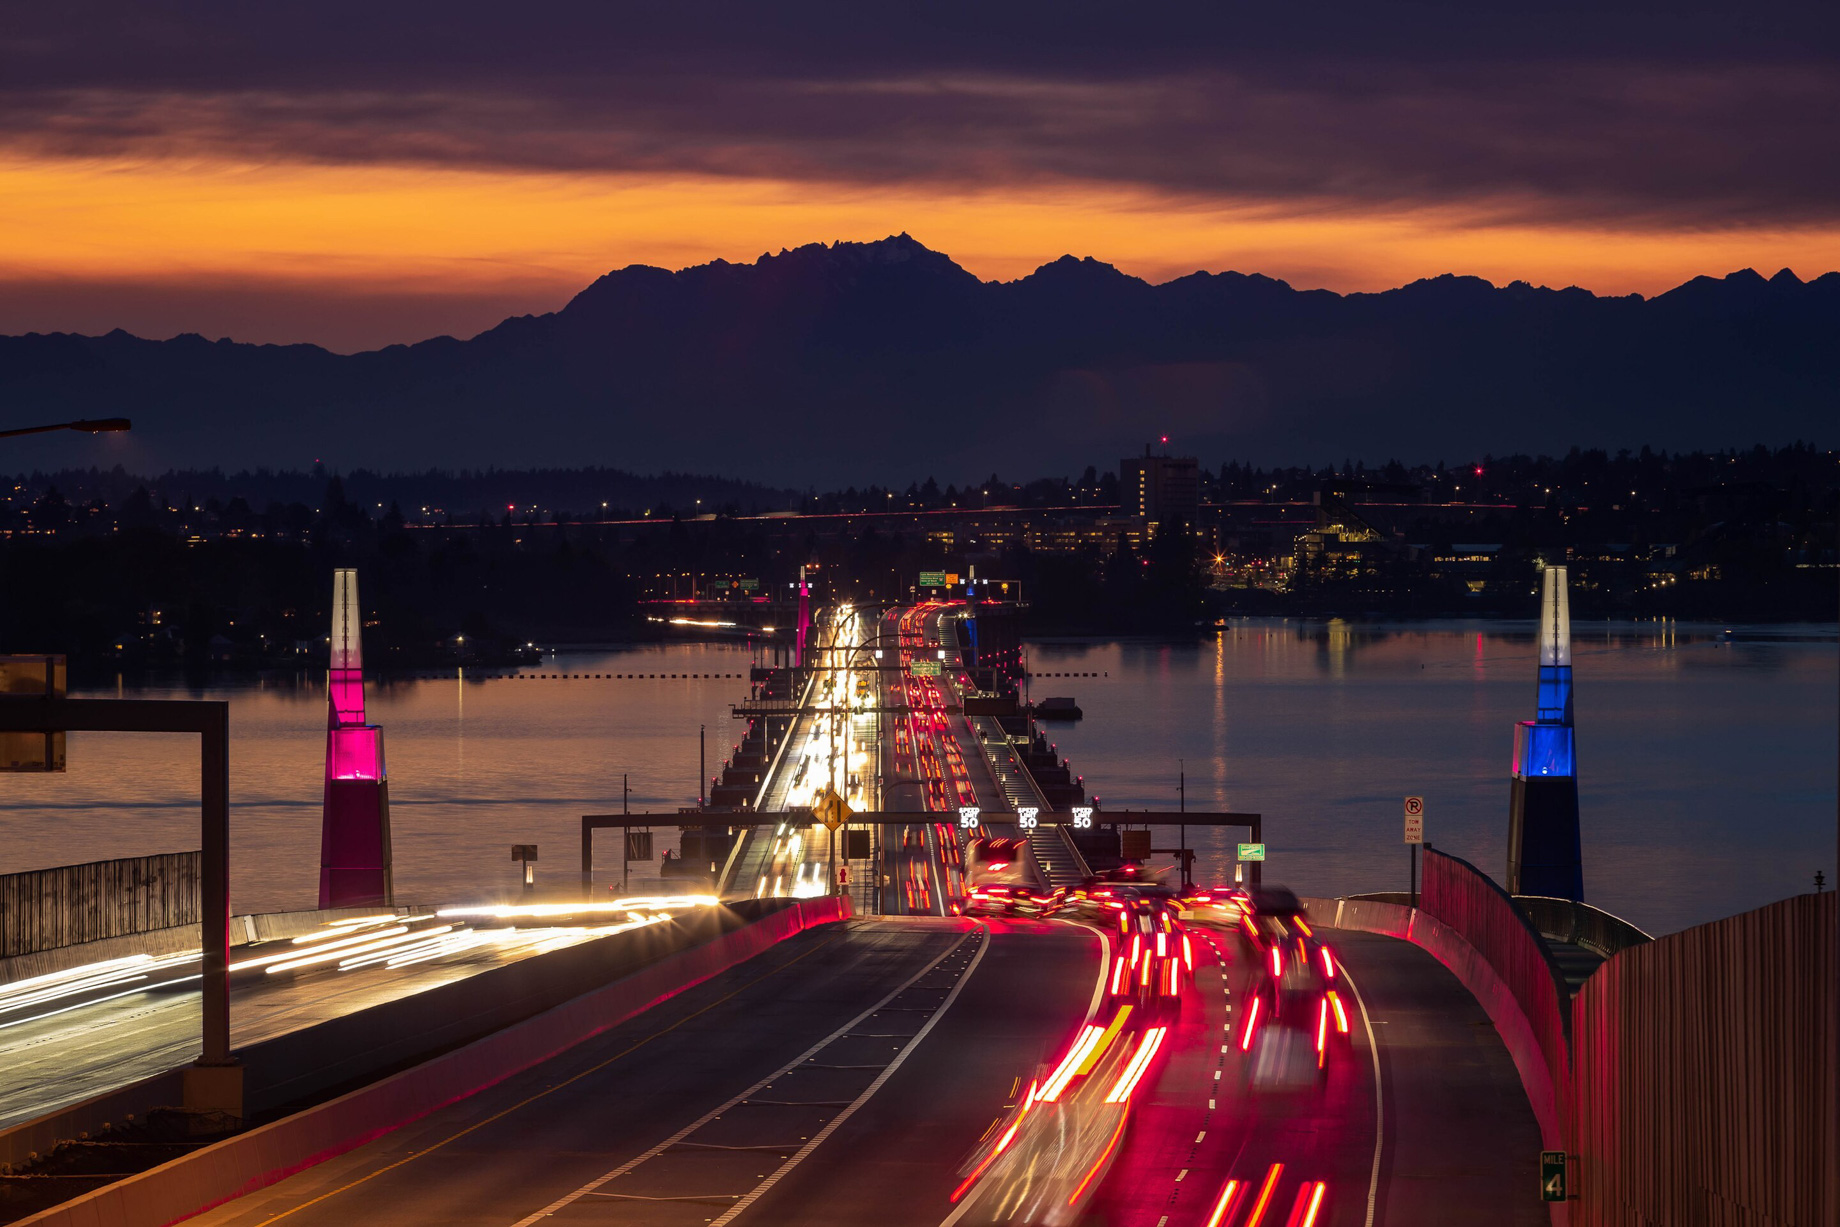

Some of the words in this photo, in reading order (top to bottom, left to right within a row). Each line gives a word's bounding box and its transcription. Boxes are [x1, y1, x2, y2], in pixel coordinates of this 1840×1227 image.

[961, 818, 978, 828] 50
[1020, 818, 1037, 828] 50
[1074, 818, 1091, 828] 50
[1544, 1154, 1564, 1165] MILE
[1545, 1173, 1563, 1197] 4
